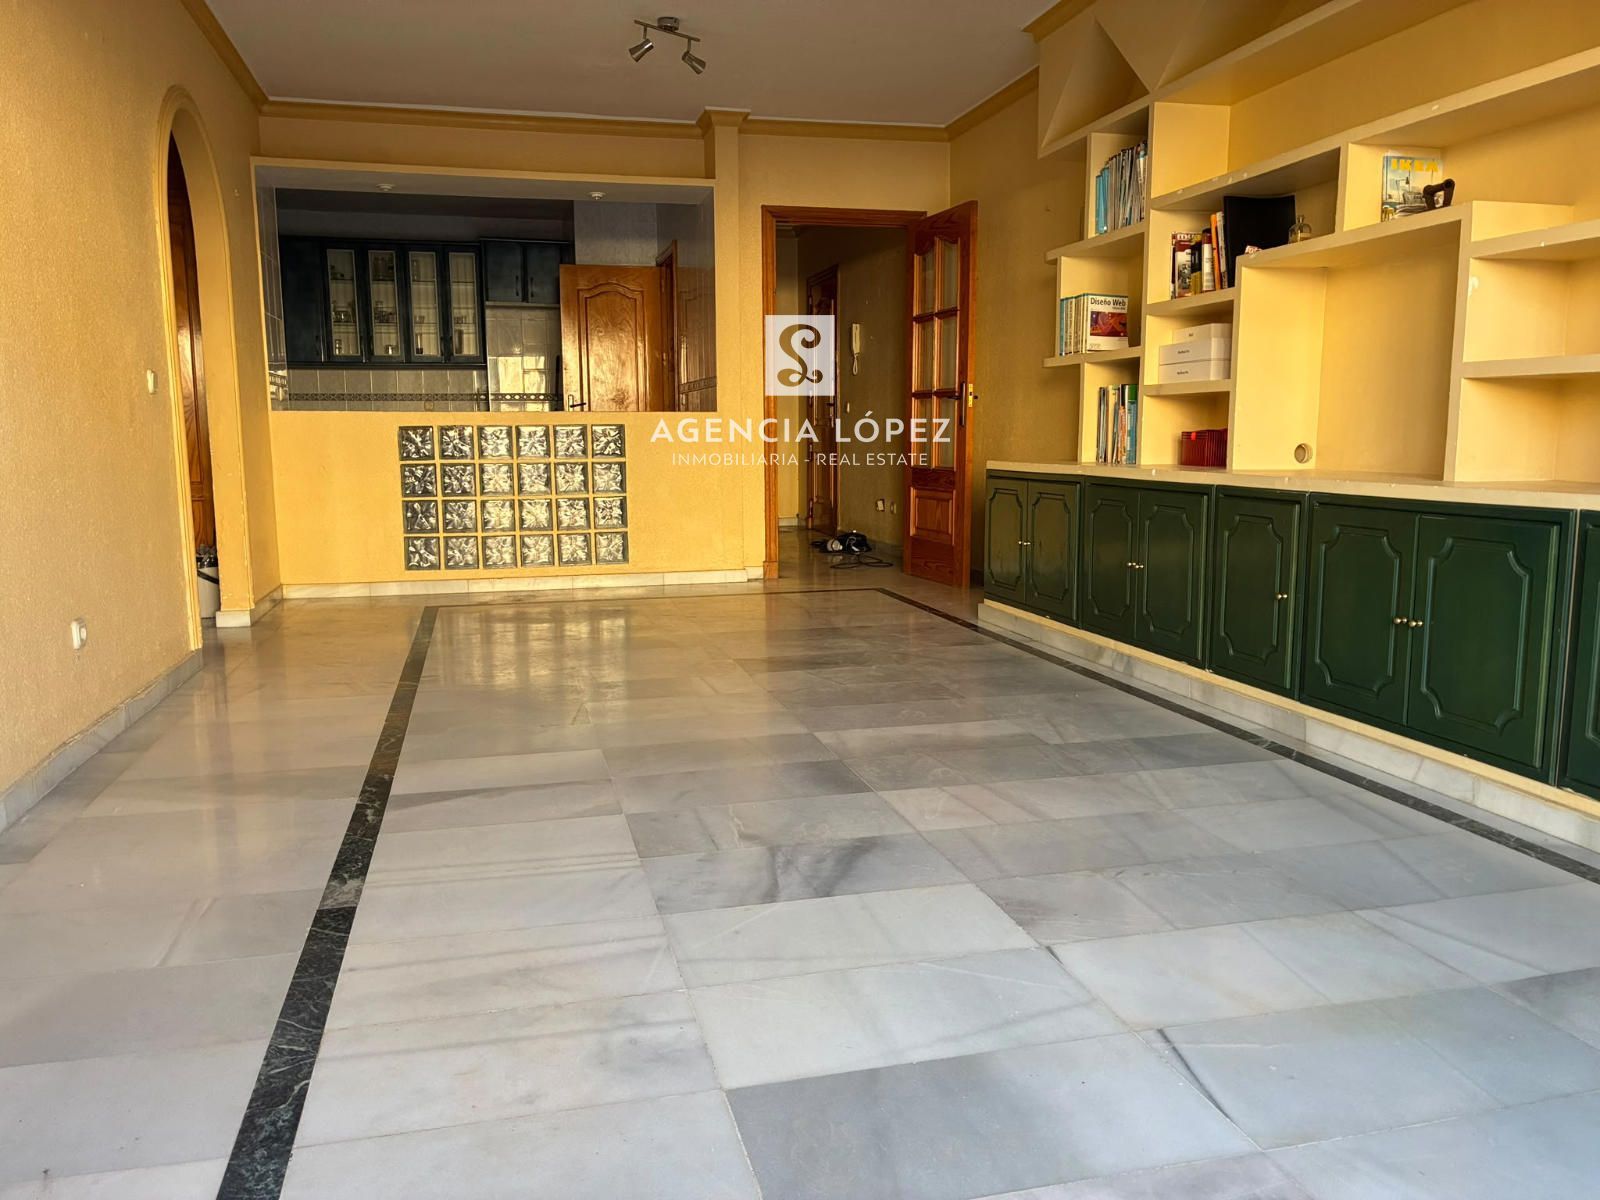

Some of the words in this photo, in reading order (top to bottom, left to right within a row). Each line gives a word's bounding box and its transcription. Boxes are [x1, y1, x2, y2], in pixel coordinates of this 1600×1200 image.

[1391, 159, 1438, 172] IKEA
[1090, 297, 1111, 306] Diseño
[1112, 298, 1126, 307] Web
